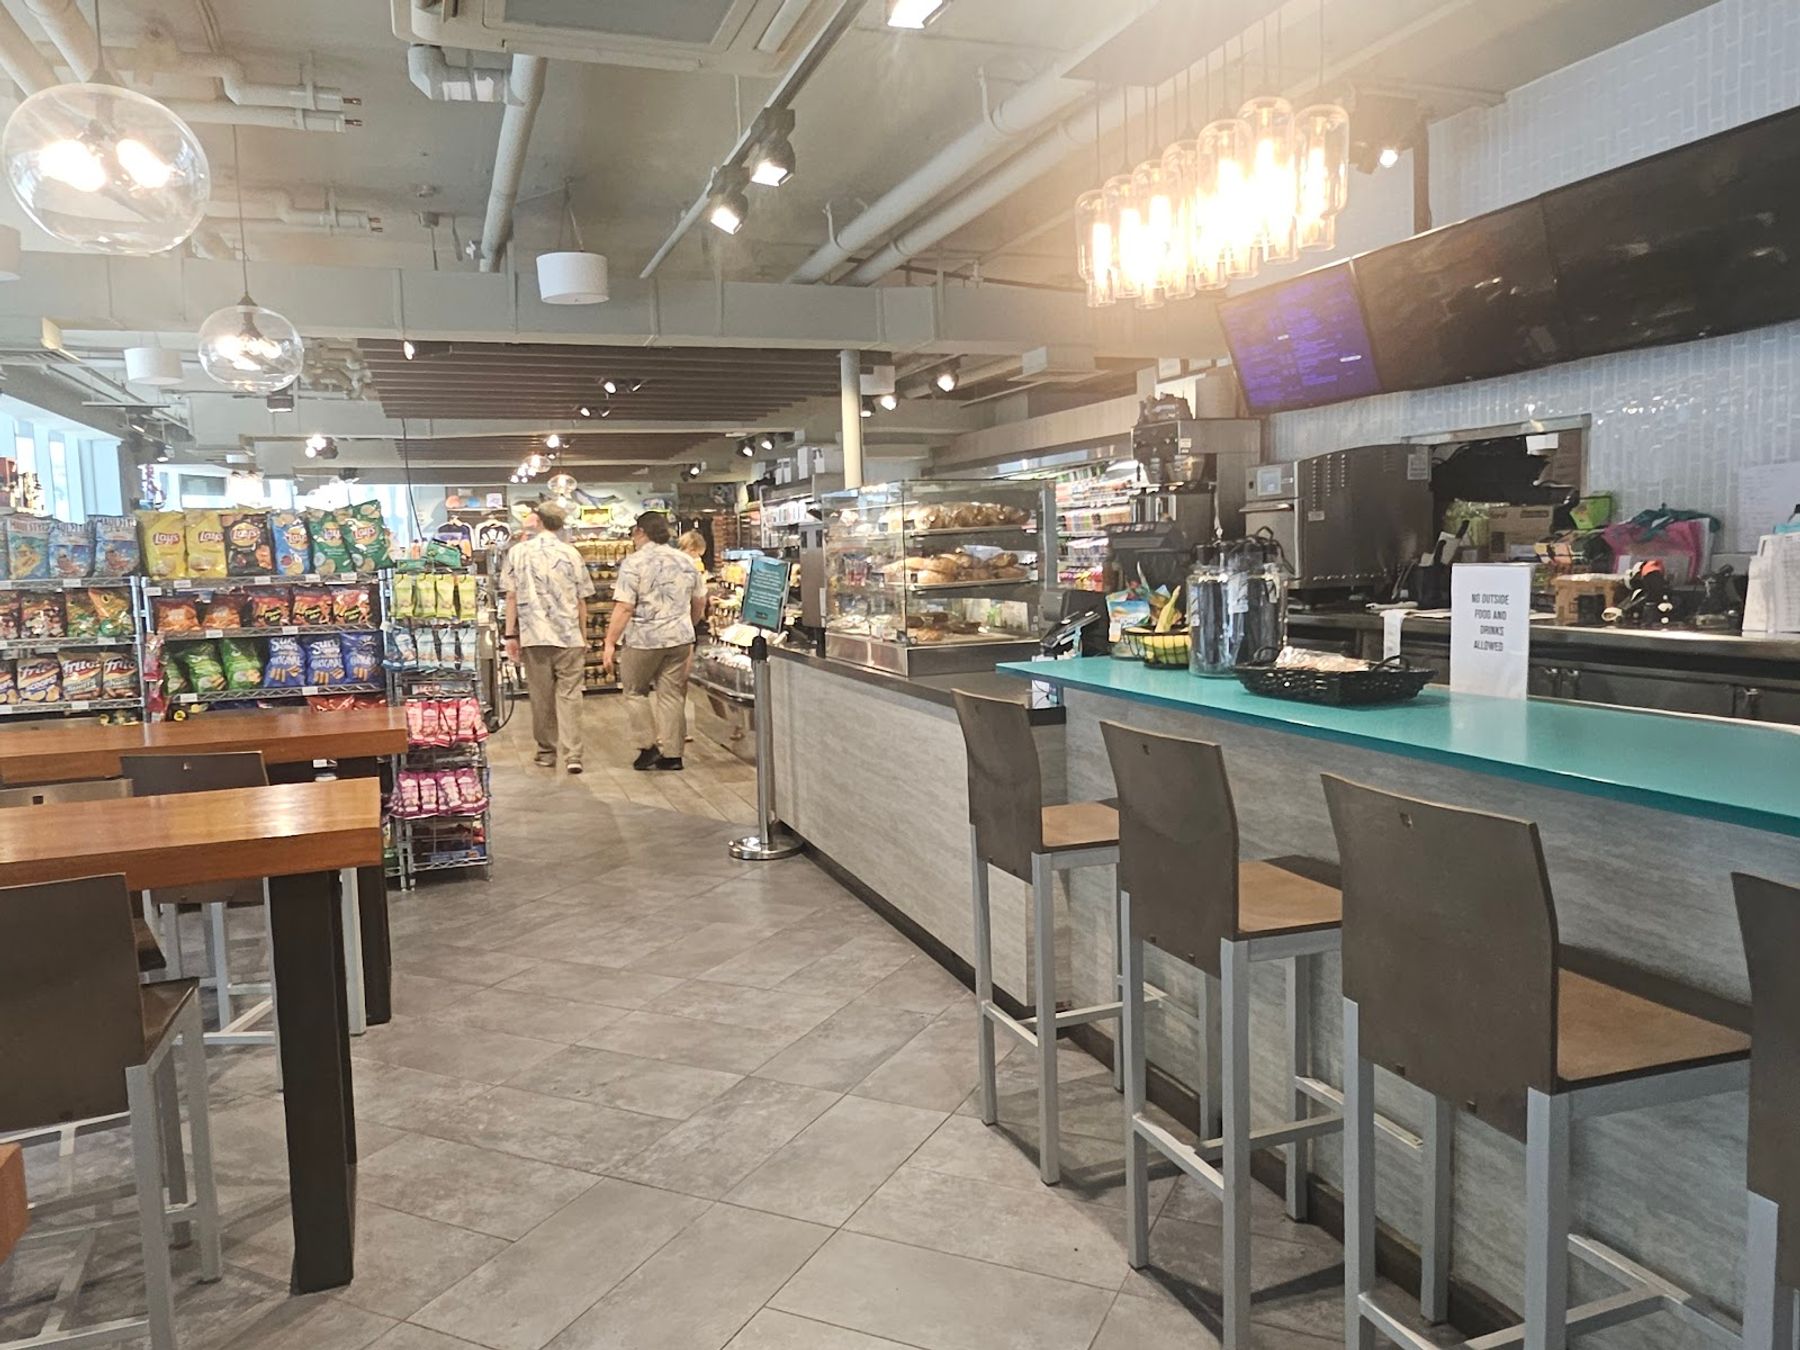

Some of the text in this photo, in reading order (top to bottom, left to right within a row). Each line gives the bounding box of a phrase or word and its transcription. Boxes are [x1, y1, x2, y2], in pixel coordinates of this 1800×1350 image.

[1472, 593, 1509, 605] NO OUTSIDE
[1474, 609, 1507, 620] FOOD AND
[1480, 625, 1504, 636] DRINKS
[1474, 641, 1503, 651] ALLOWED
